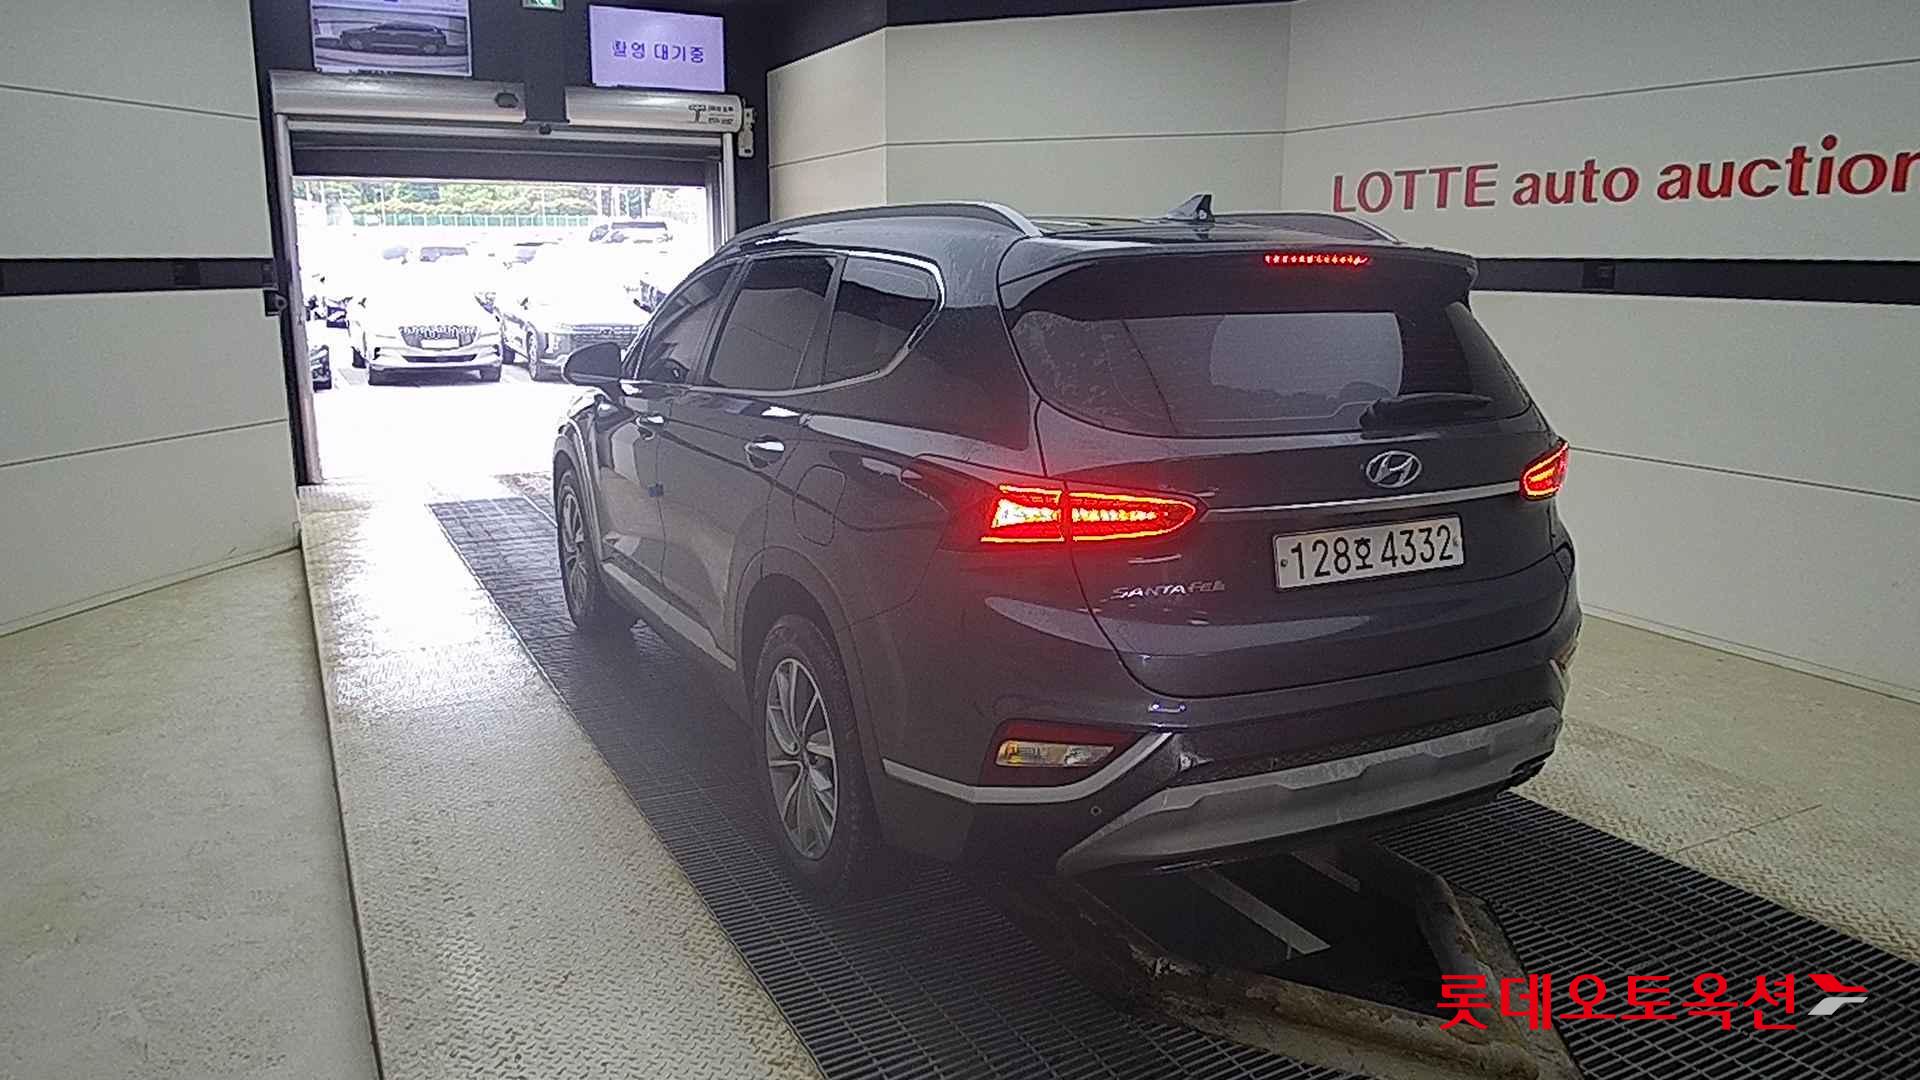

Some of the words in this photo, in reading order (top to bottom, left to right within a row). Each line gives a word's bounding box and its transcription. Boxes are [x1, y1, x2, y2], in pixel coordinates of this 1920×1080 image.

[654, 43, 704, 63] 대기중
[1333, 163, 1499, 213] LOTTE
[1512, 158, 1640, 206] auto
